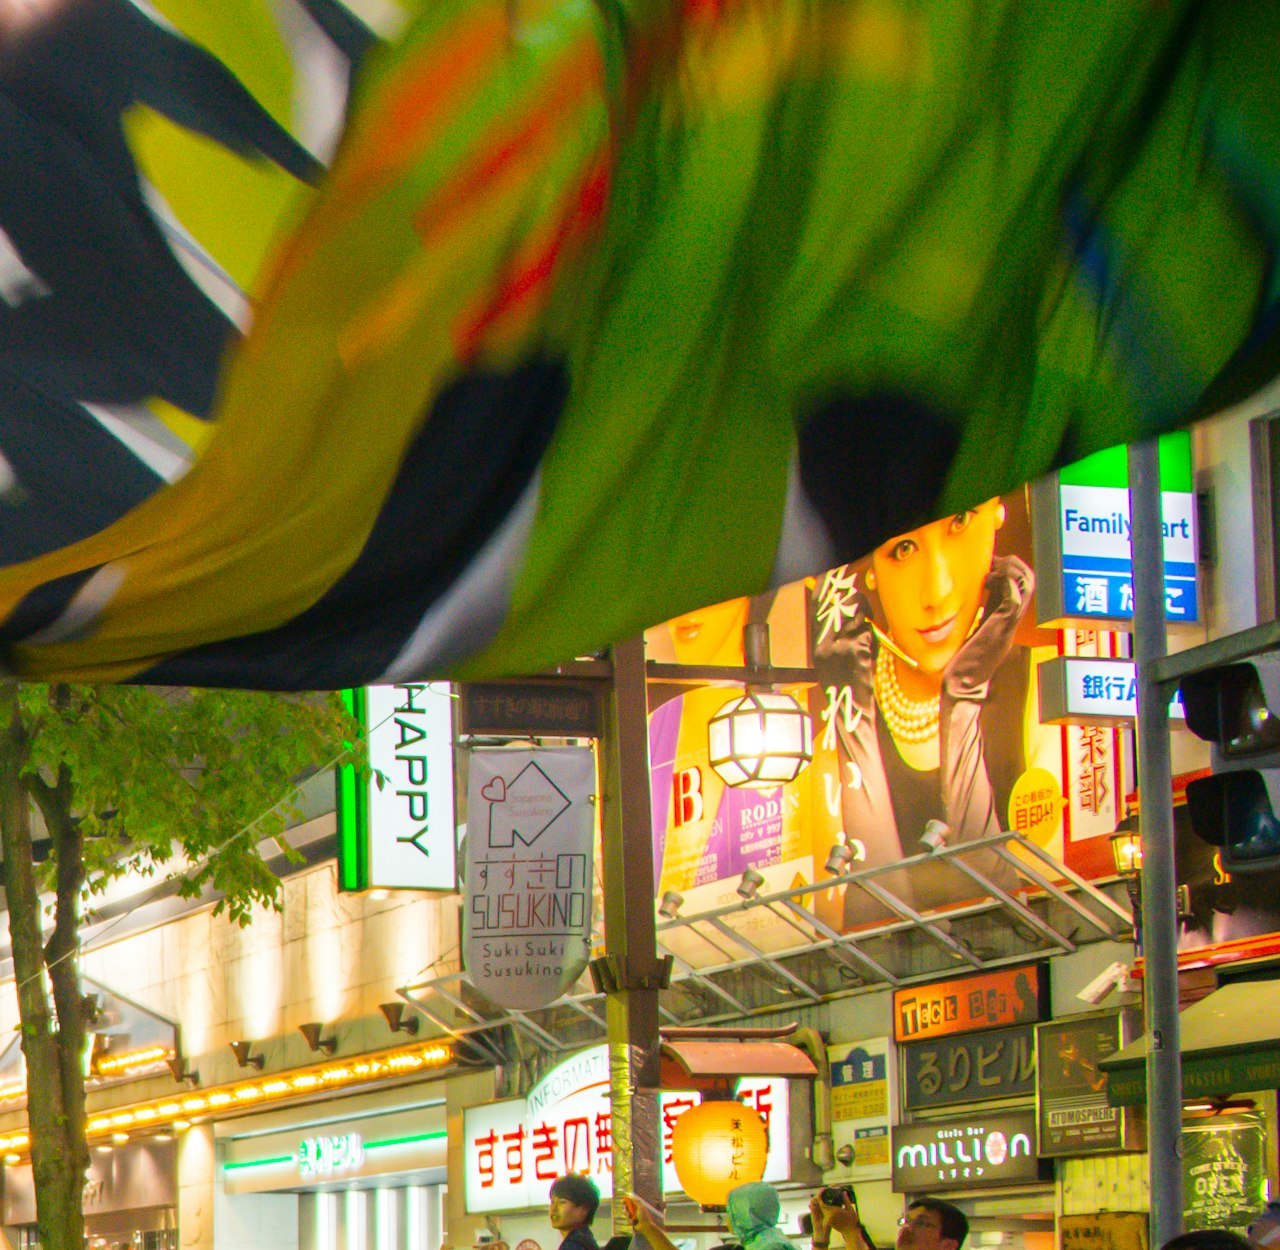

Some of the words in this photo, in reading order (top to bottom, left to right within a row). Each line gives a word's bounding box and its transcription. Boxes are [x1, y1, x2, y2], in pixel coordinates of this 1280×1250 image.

[1065, 509, 1189, 541] Familyart
[1075, 576, 1109, 614] 酒
[394, 684, 429, 857] HAPPY
[474, 852, 586, 890] すすきの
[472, 892, 585, 930] SUSUKINO
[483, 943, 518, 958] Suki
[525, 941, 564, 957] Suki
[483, 961, 563, 978] Susukino
[530, 1053, 610, 1117] INFORMATI
[917, 1037, 1035, 1096] るりビル
